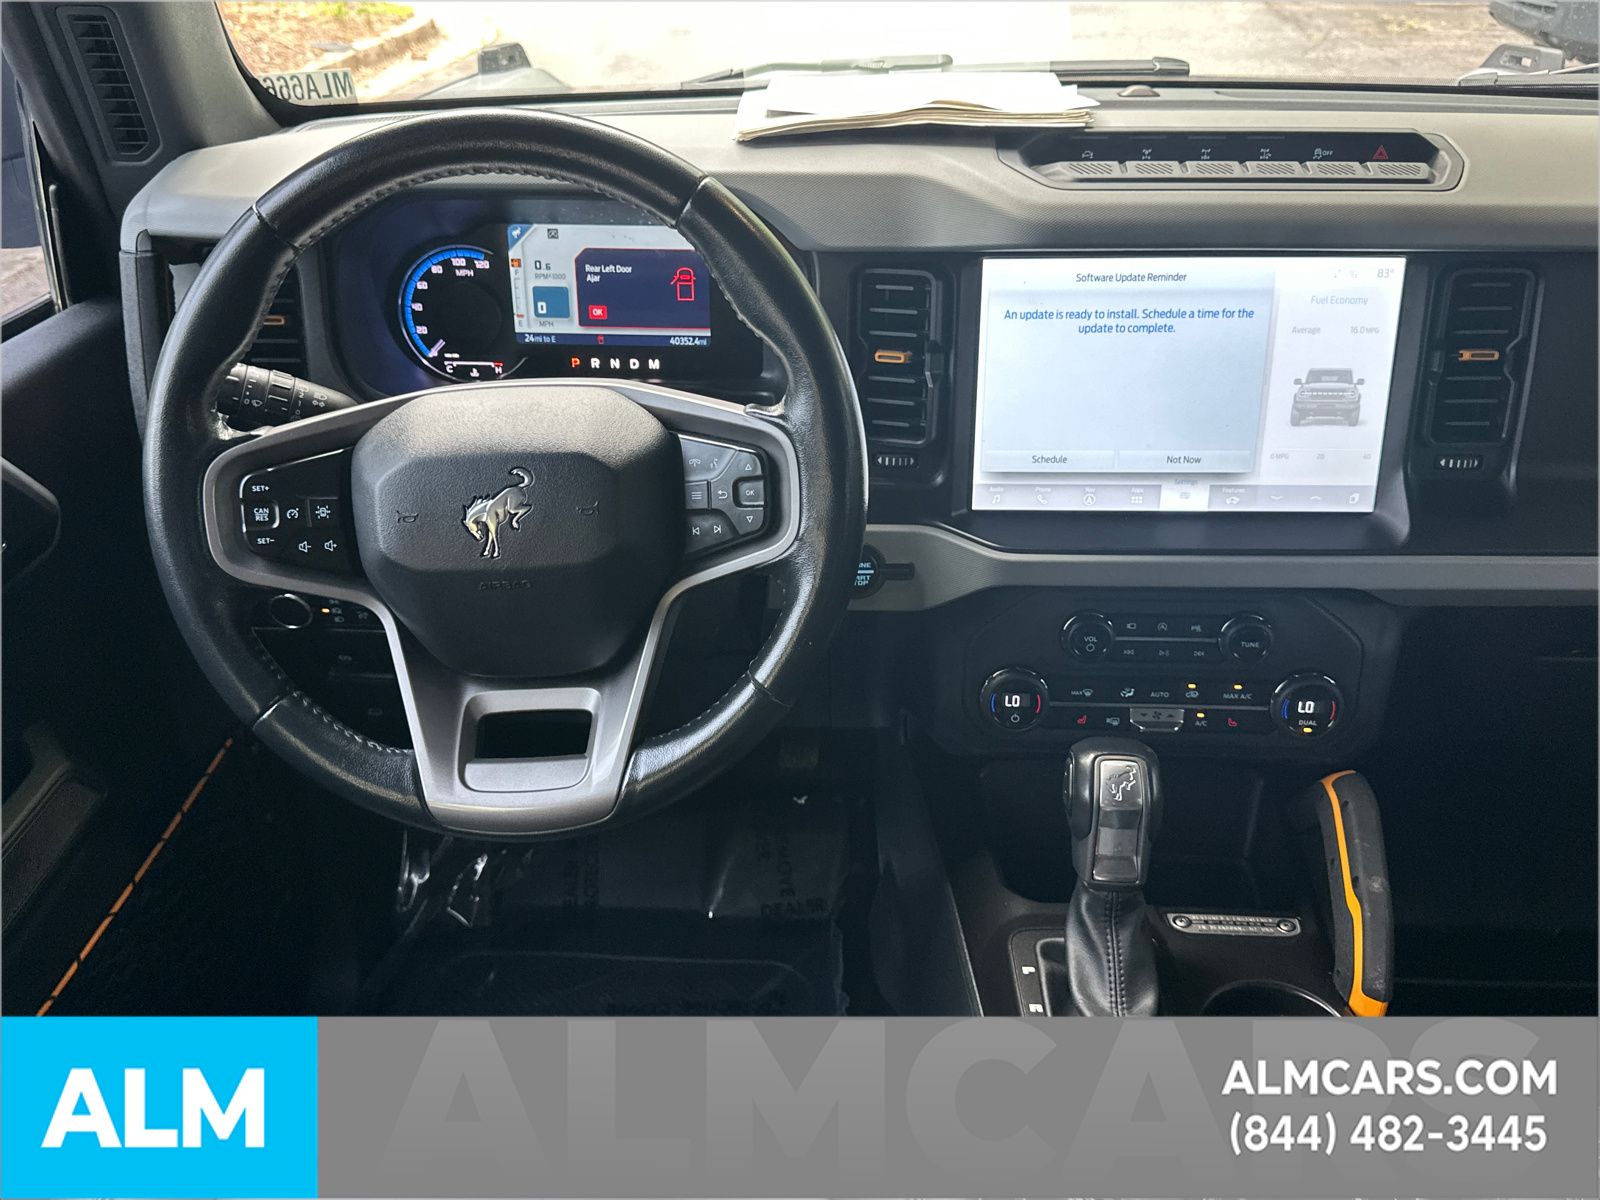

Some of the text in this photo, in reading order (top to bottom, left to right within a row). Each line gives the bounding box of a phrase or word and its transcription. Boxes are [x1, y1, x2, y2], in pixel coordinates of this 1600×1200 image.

[451, 258, 466, 266] 100
[474, 260, 490, 268] 120
[585, 264, 601, 273] Rear
[586, 274, 600, 282] Ajar
[1076, 273, 1186, 283] Software Update Reminder
[1311, 296, 1368, 306] Fuel Economy
[1004, 310, 1017, 319] An
[1020, 310, 1054, 321] update
[1056, 310, 1063, 319] is
[1066, 309, 1092, 320] ready
[1095, 310, 1105, 319] to
[1107, 309, 1139, 319] install.
[1142, 309, 1187, 318] Schedule
[1197, 309, 1220, 318] time
[1222, 308, 1236, 318] for
[1238, 308, 1254, 318] the
[416, 326, 428, 334] 20
[1078, 324, 1113, 334] update
[1128, 323, 1175, 334] complete.
[1292, 326, 1321, 334] Average
[572, 358, 660, 369] P R N D M
[1032, 455, 1068, 464] Schedule
[1167, 455, 1201, 464] Not Now
[1004, 695, 1020, 707] LO
[1298, 701, 1315, 713] LO
